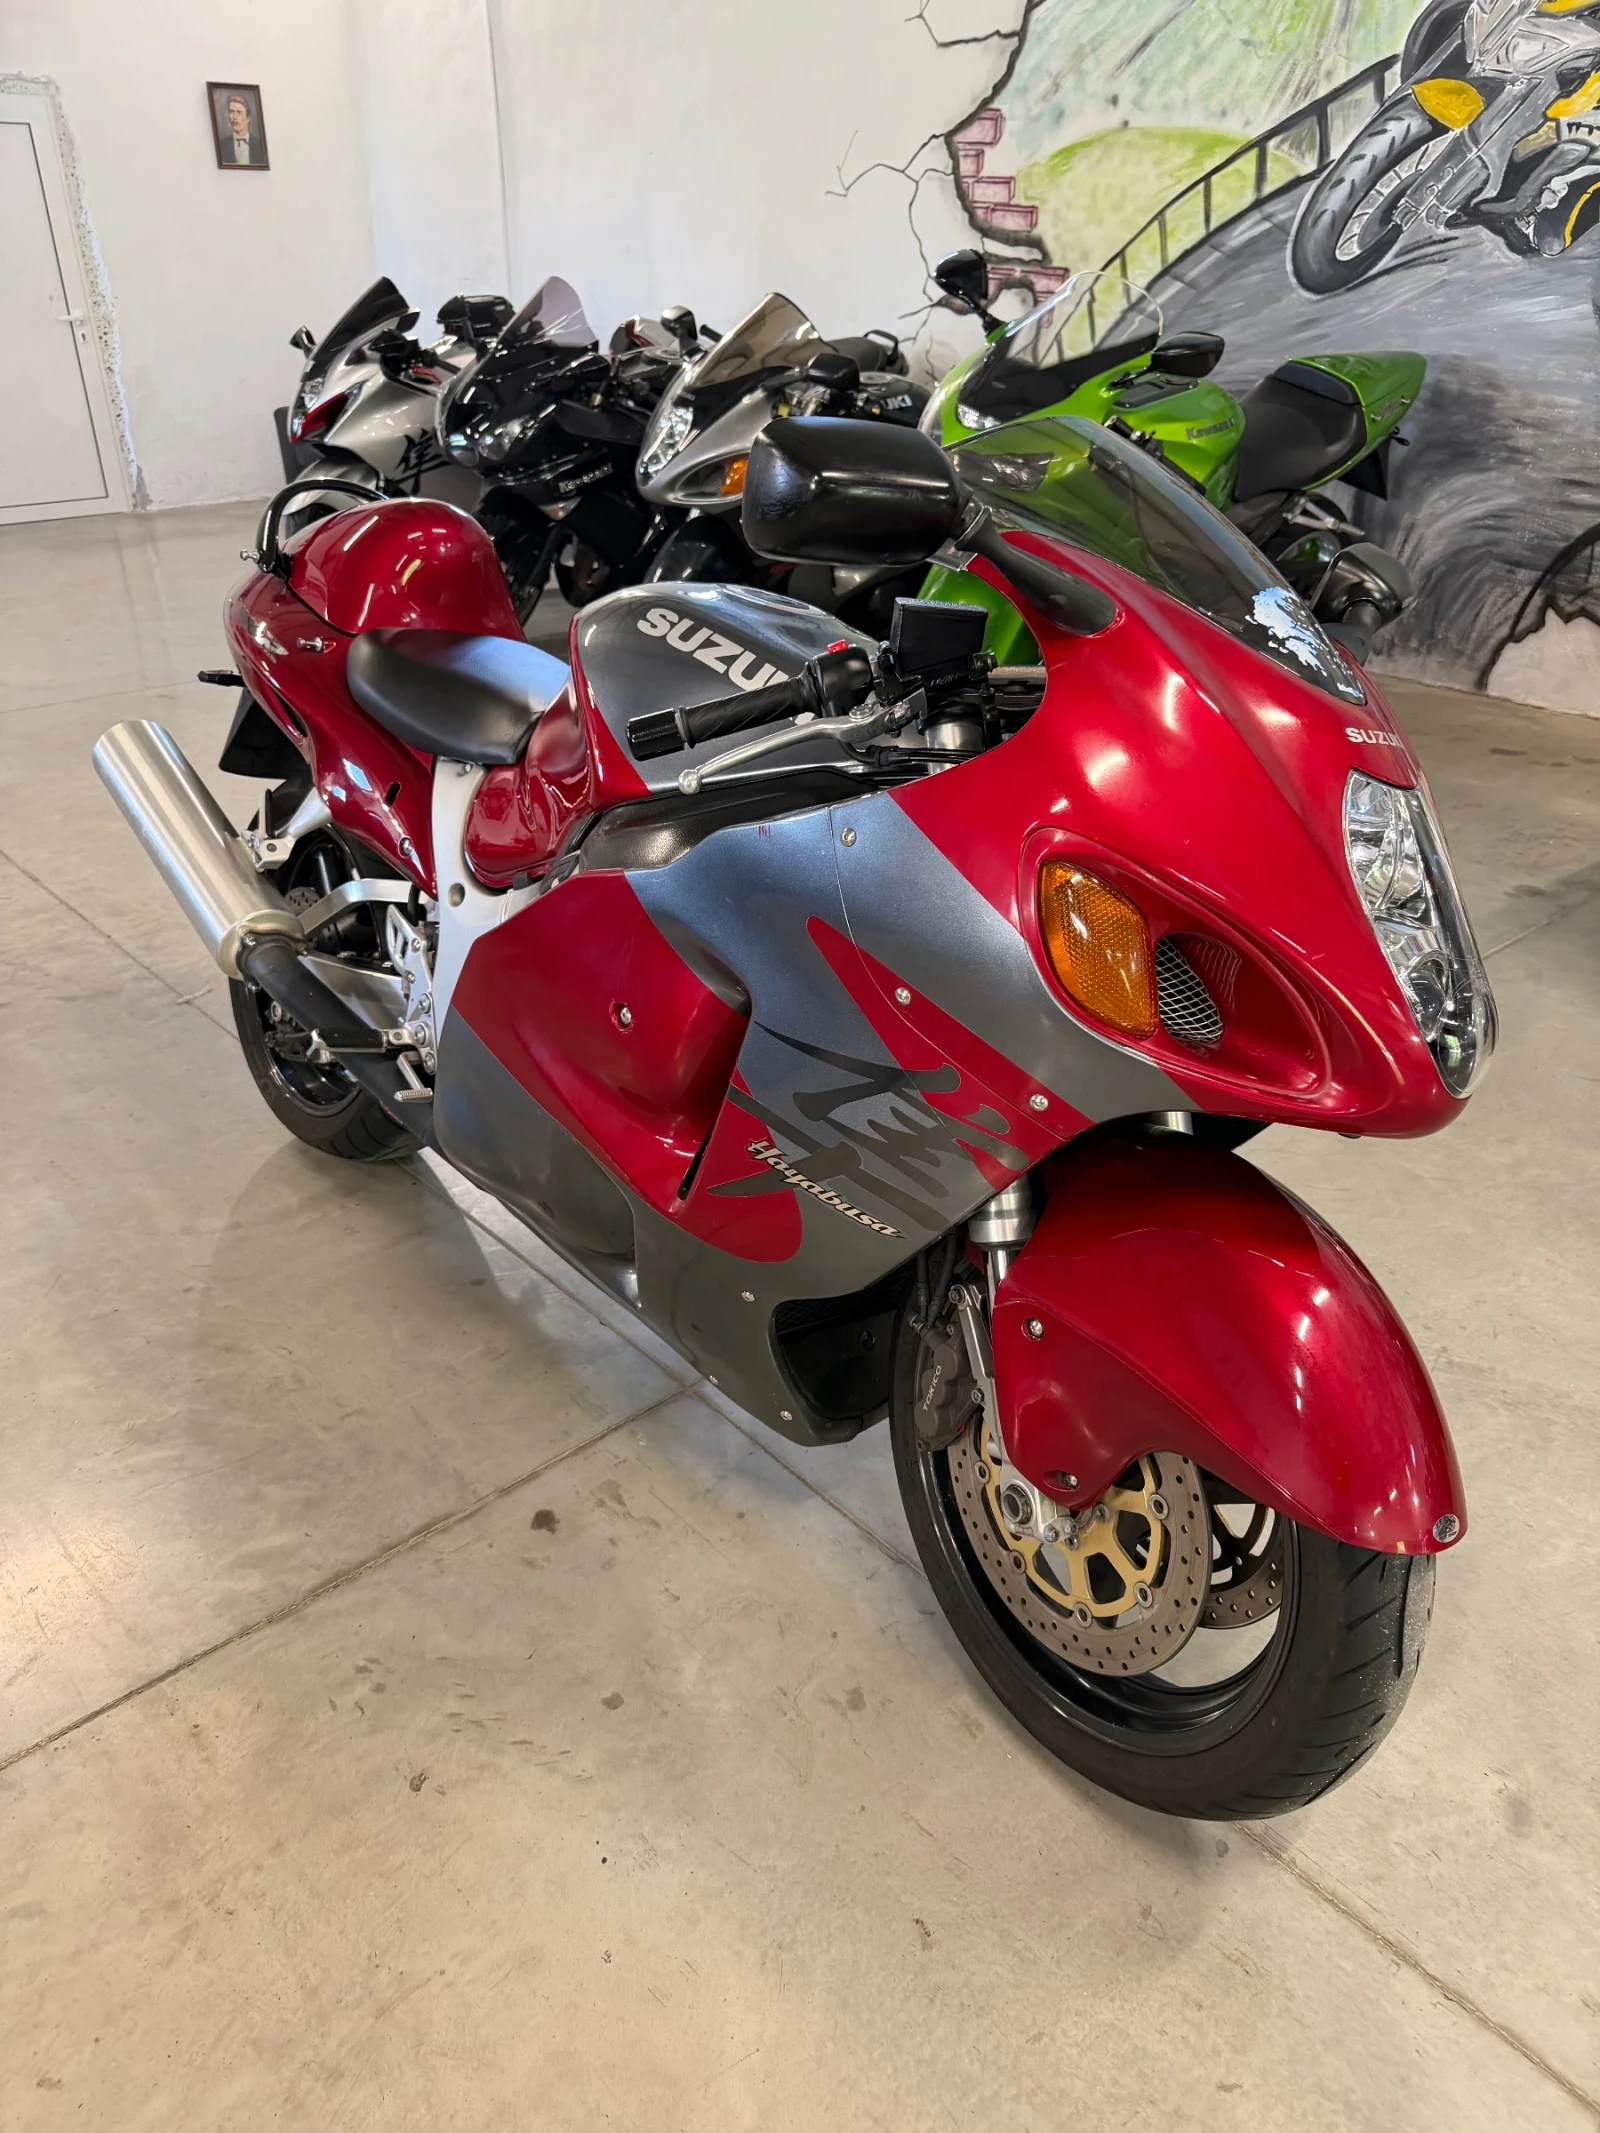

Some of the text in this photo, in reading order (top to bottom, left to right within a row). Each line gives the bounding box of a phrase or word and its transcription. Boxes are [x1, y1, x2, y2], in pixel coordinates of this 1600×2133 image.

[636, 607, 790, 692] SUZU
[745, 1138, 910, 1240] Hayabusa
[922, 1364, 942, 1412] TOKICO
